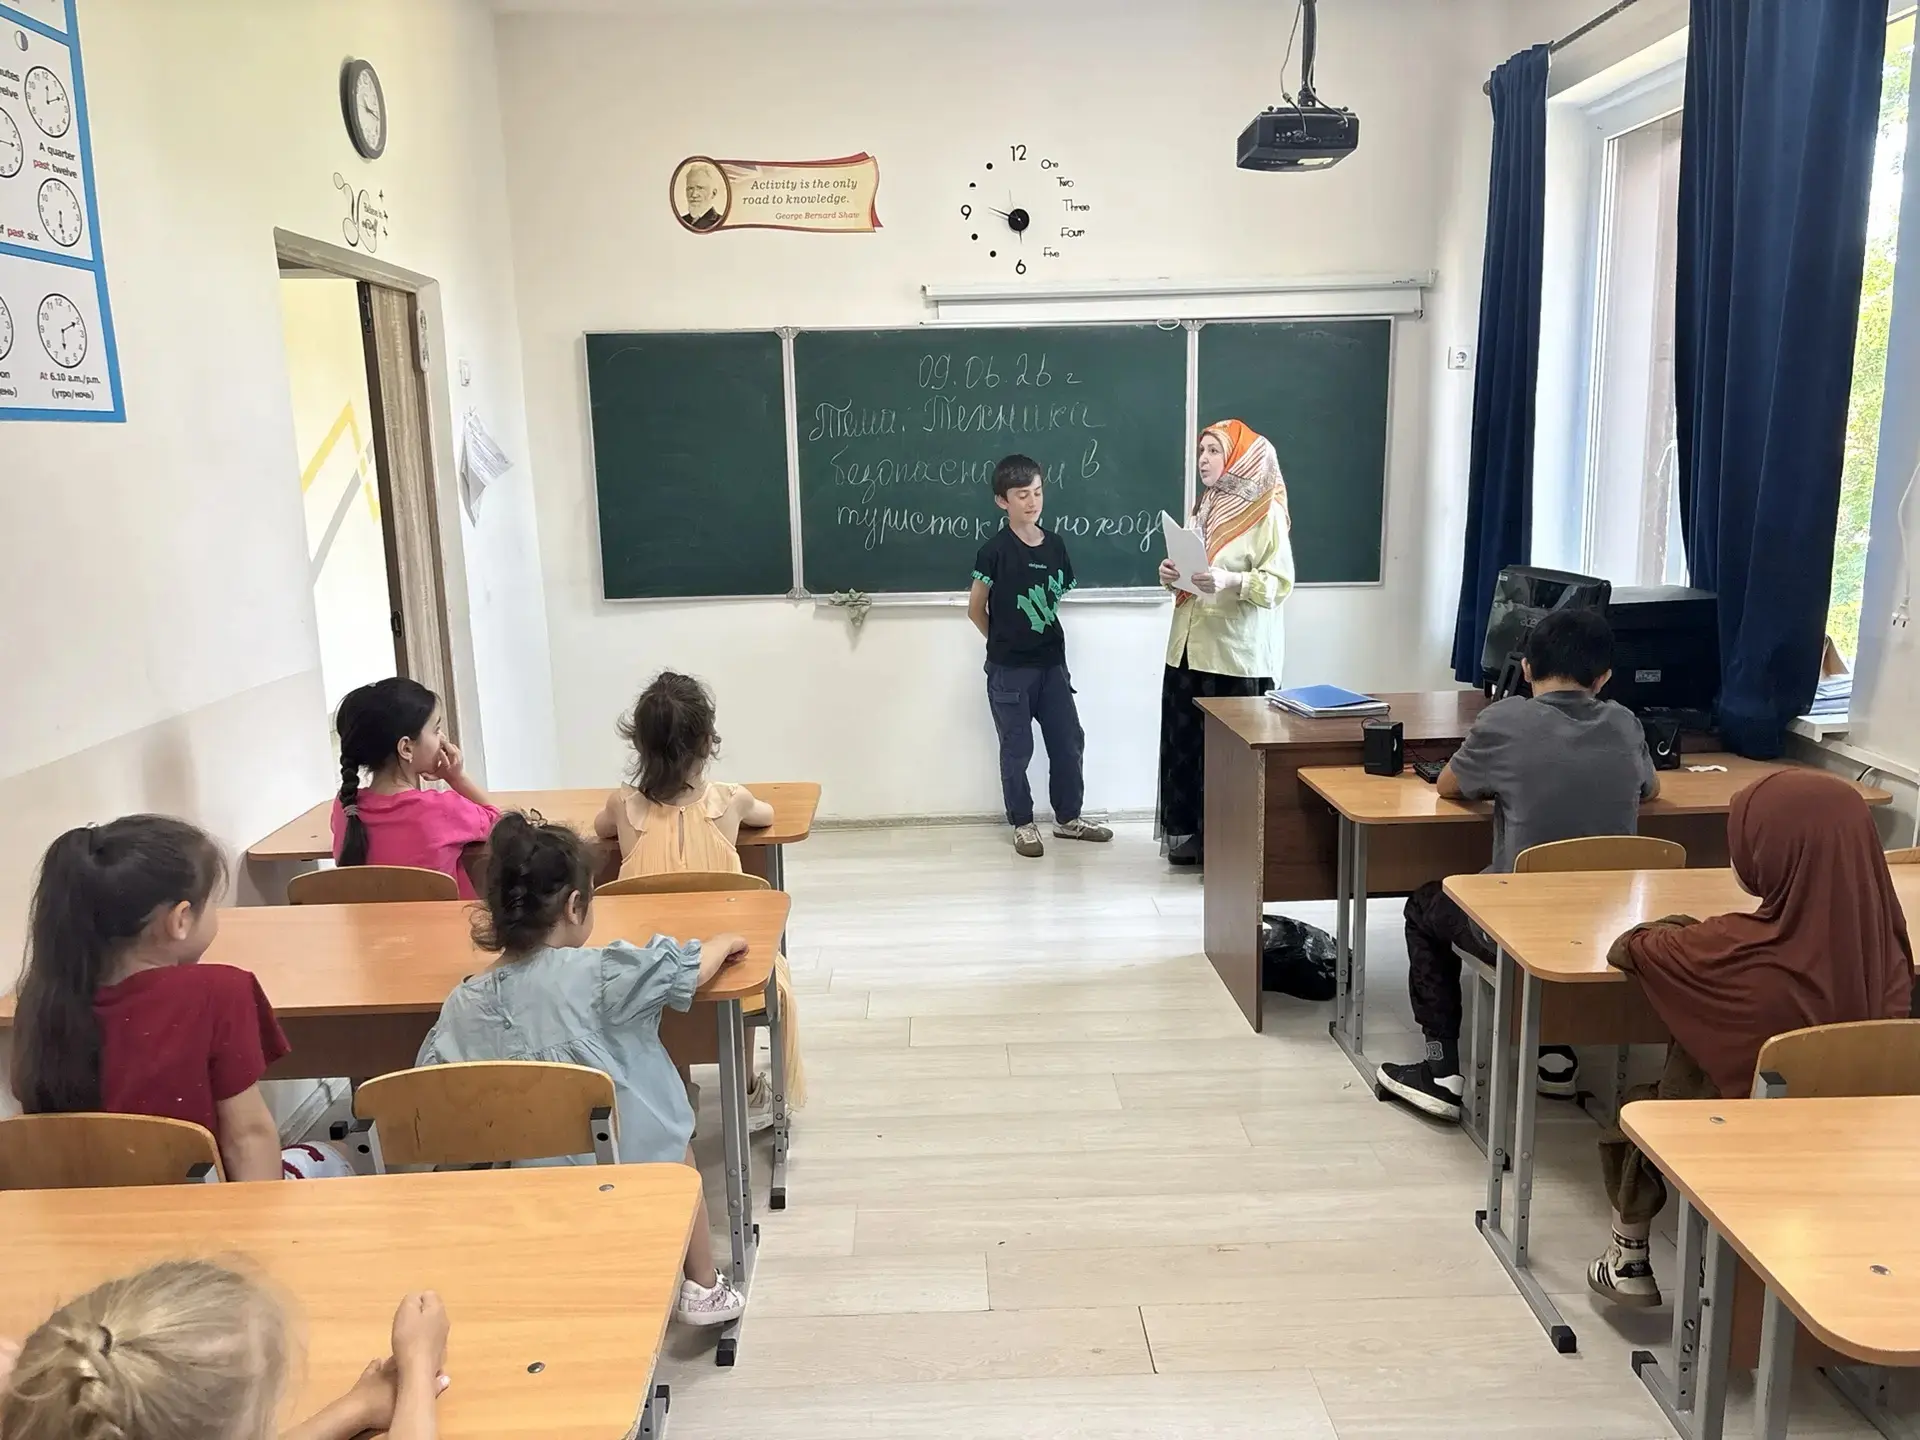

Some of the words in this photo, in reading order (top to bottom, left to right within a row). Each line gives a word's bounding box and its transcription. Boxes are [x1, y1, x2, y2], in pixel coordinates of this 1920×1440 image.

[40, 142, 45, 152] A
[48, 146, 75, 161] quarter
[1010, 144, 1026, 161] 12
[33, 159, 50, 171] past
[52, 164, 77, 178] twelve
[1041, 159, 1058, 169] One
[751, 180, 797, 191] Activity
[800, 180, 809, 189] is
[812, 179, 830, 188] the
[833, 178, 858, 192] only
[1056, 177, 1074, 187] Two
[743, 195, 769, 204] road
[772, 195, 783, 204] to
[786, 194, 850, 205] knowledge.
[1062, 199, 1090, 211] Three
[960, 205, 972, 220] 9
[7, 228, 25, 238] past
[27, 231, 40, 241] six
[1060, 227, 1085, 238] Four
[1043, 247, 1059, 257] Five
[1015, 259, 1026, 274] 6
[40, 372, 48, 380] At
[50, 373, 66, 381] 6.10
[52, 388, 94, 400] (утро/ночь)
[923, 395, 1106, 434] Техника
[1426, 1041, 1444, 1060] B
